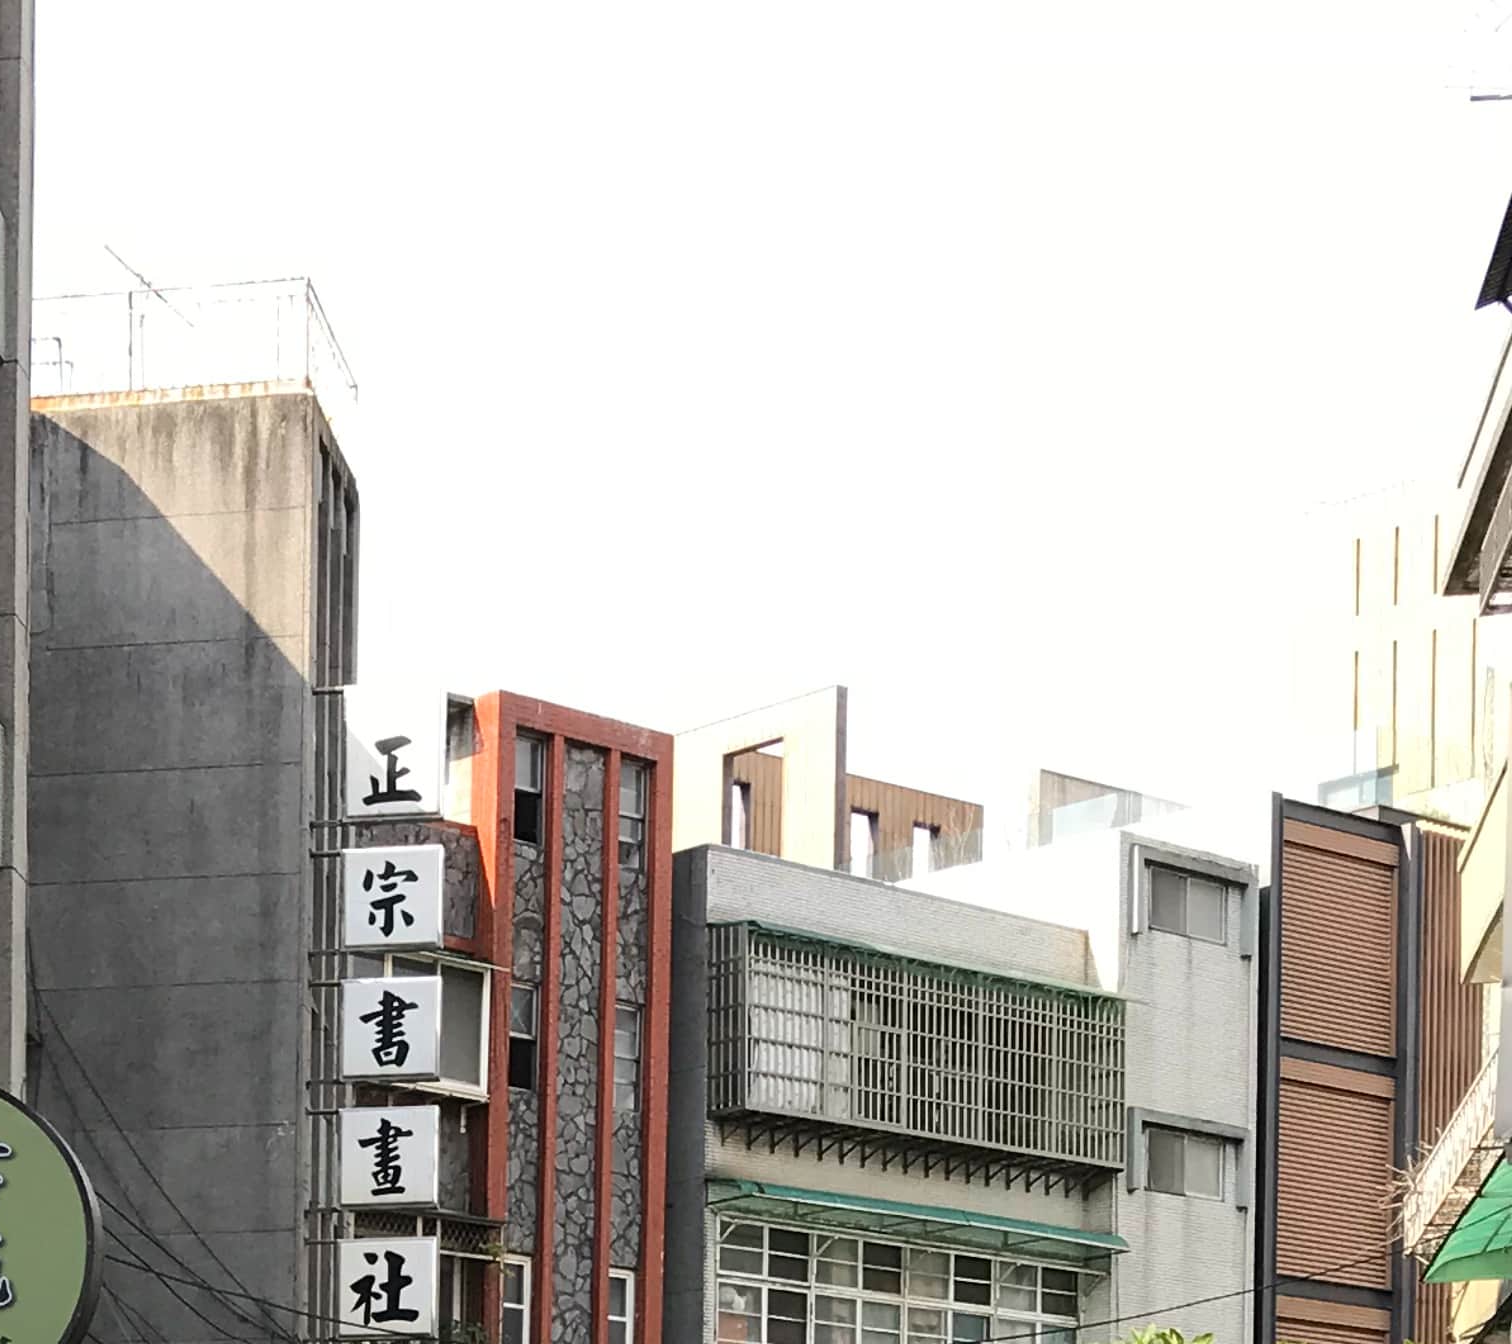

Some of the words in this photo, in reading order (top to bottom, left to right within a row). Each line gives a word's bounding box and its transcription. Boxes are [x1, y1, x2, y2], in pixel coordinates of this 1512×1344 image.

[348, 735, 423, 1328] 正宗書畫社
